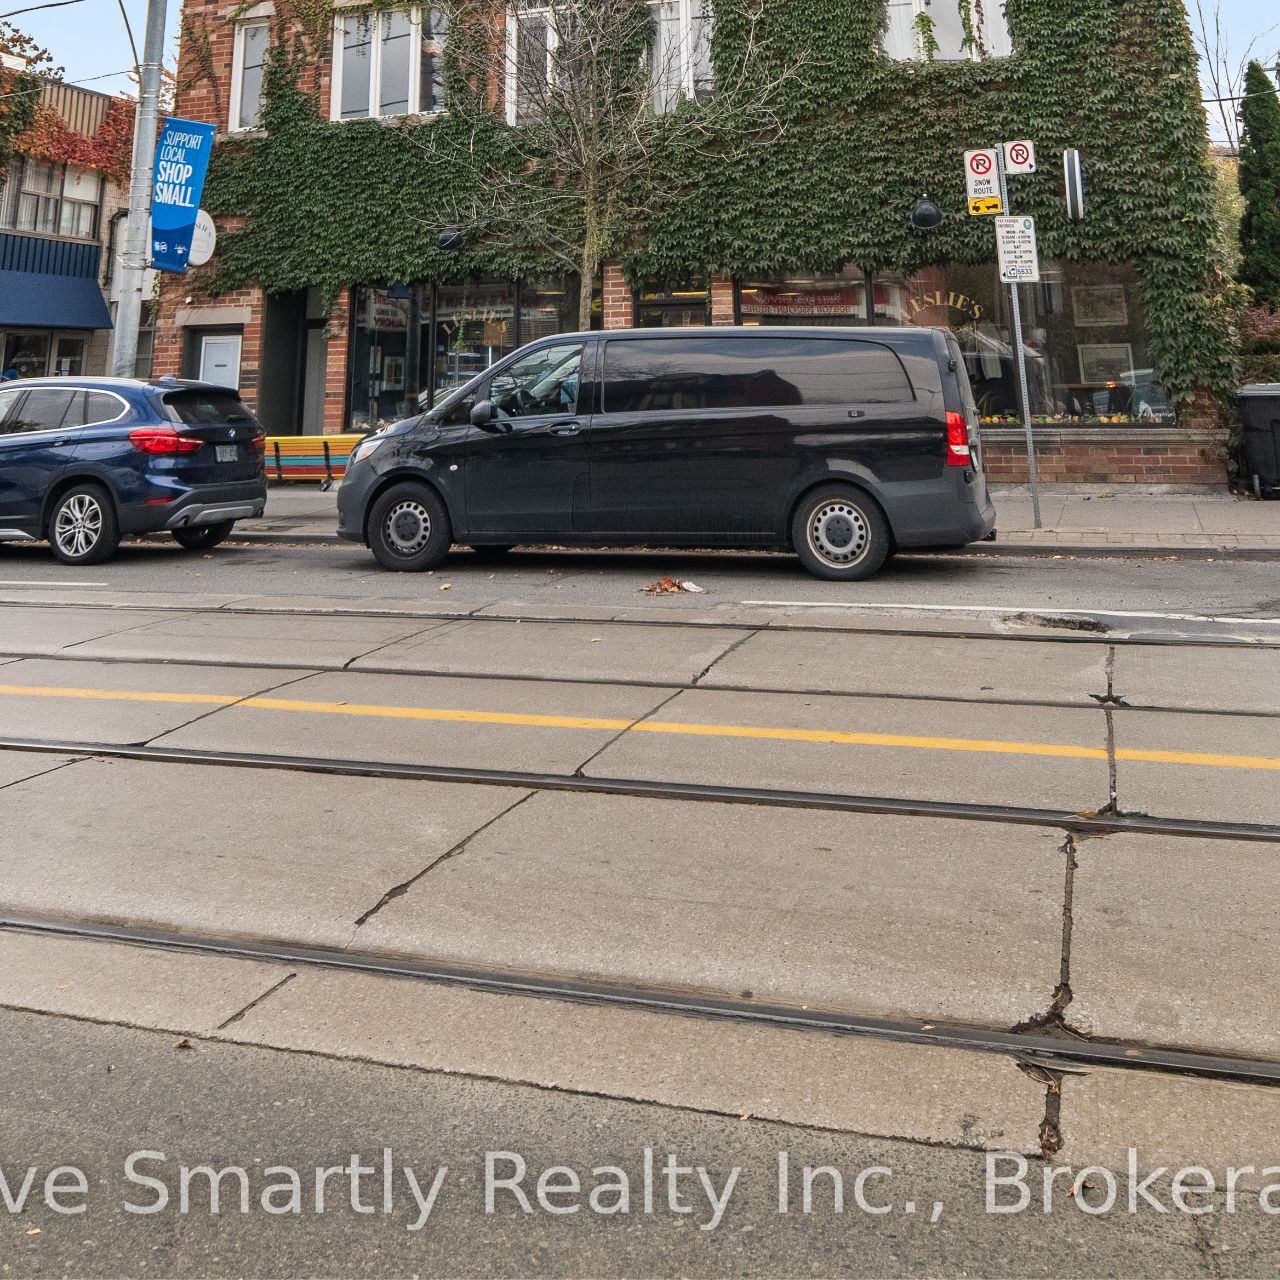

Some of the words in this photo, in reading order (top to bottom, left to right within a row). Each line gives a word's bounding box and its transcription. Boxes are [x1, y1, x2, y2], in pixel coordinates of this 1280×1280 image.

[164, 131, 203, 150] SUPPORT
[160, 145, 187, 164] LOCAL
[157, 161, 193, 185] SHOP
[973, 187, 993, 195] ROUTE
[974, 179, 991, 187] SNOW
[155, 182, 195, 208] SMALL
[901, 290, 984, 325] LESLIE'S
